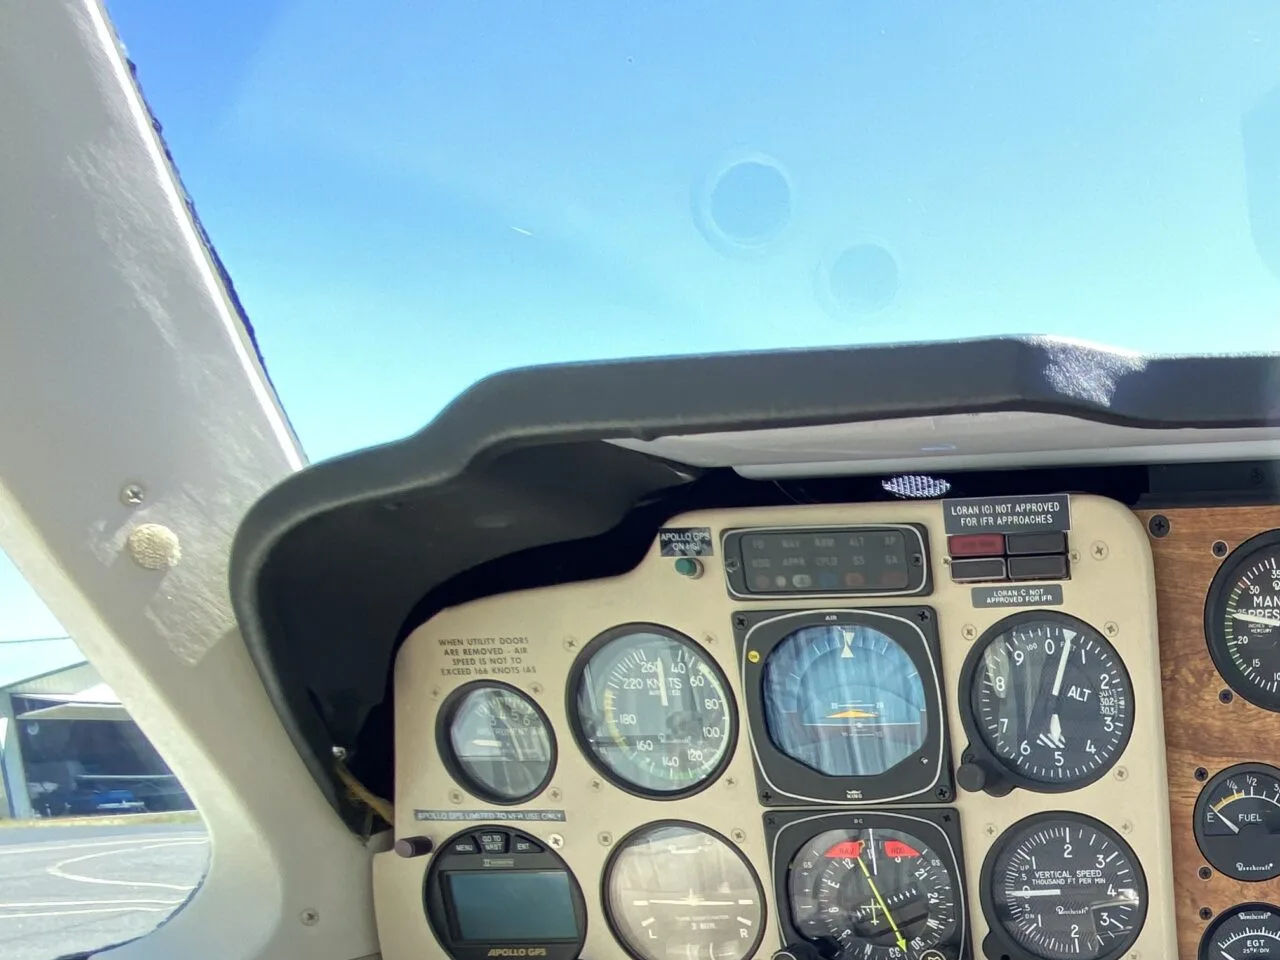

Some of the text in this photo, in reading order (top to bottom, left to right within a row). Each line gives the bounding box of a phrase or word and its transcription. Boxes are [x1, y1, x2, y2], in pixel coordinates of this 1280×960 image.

[951, 502, 1059, 515] LORAN NOT APPROVED
[961, 515, 1052, 526] FOR IFR APPROACHES
[1045, 639, 1054, 654] 0
[624, 679, 643, 689] 220
[690, 677, 704, 686] 60
[1068, 686, 1091, 701] ALT
[1238, 814, 1262, 822] FUEL
